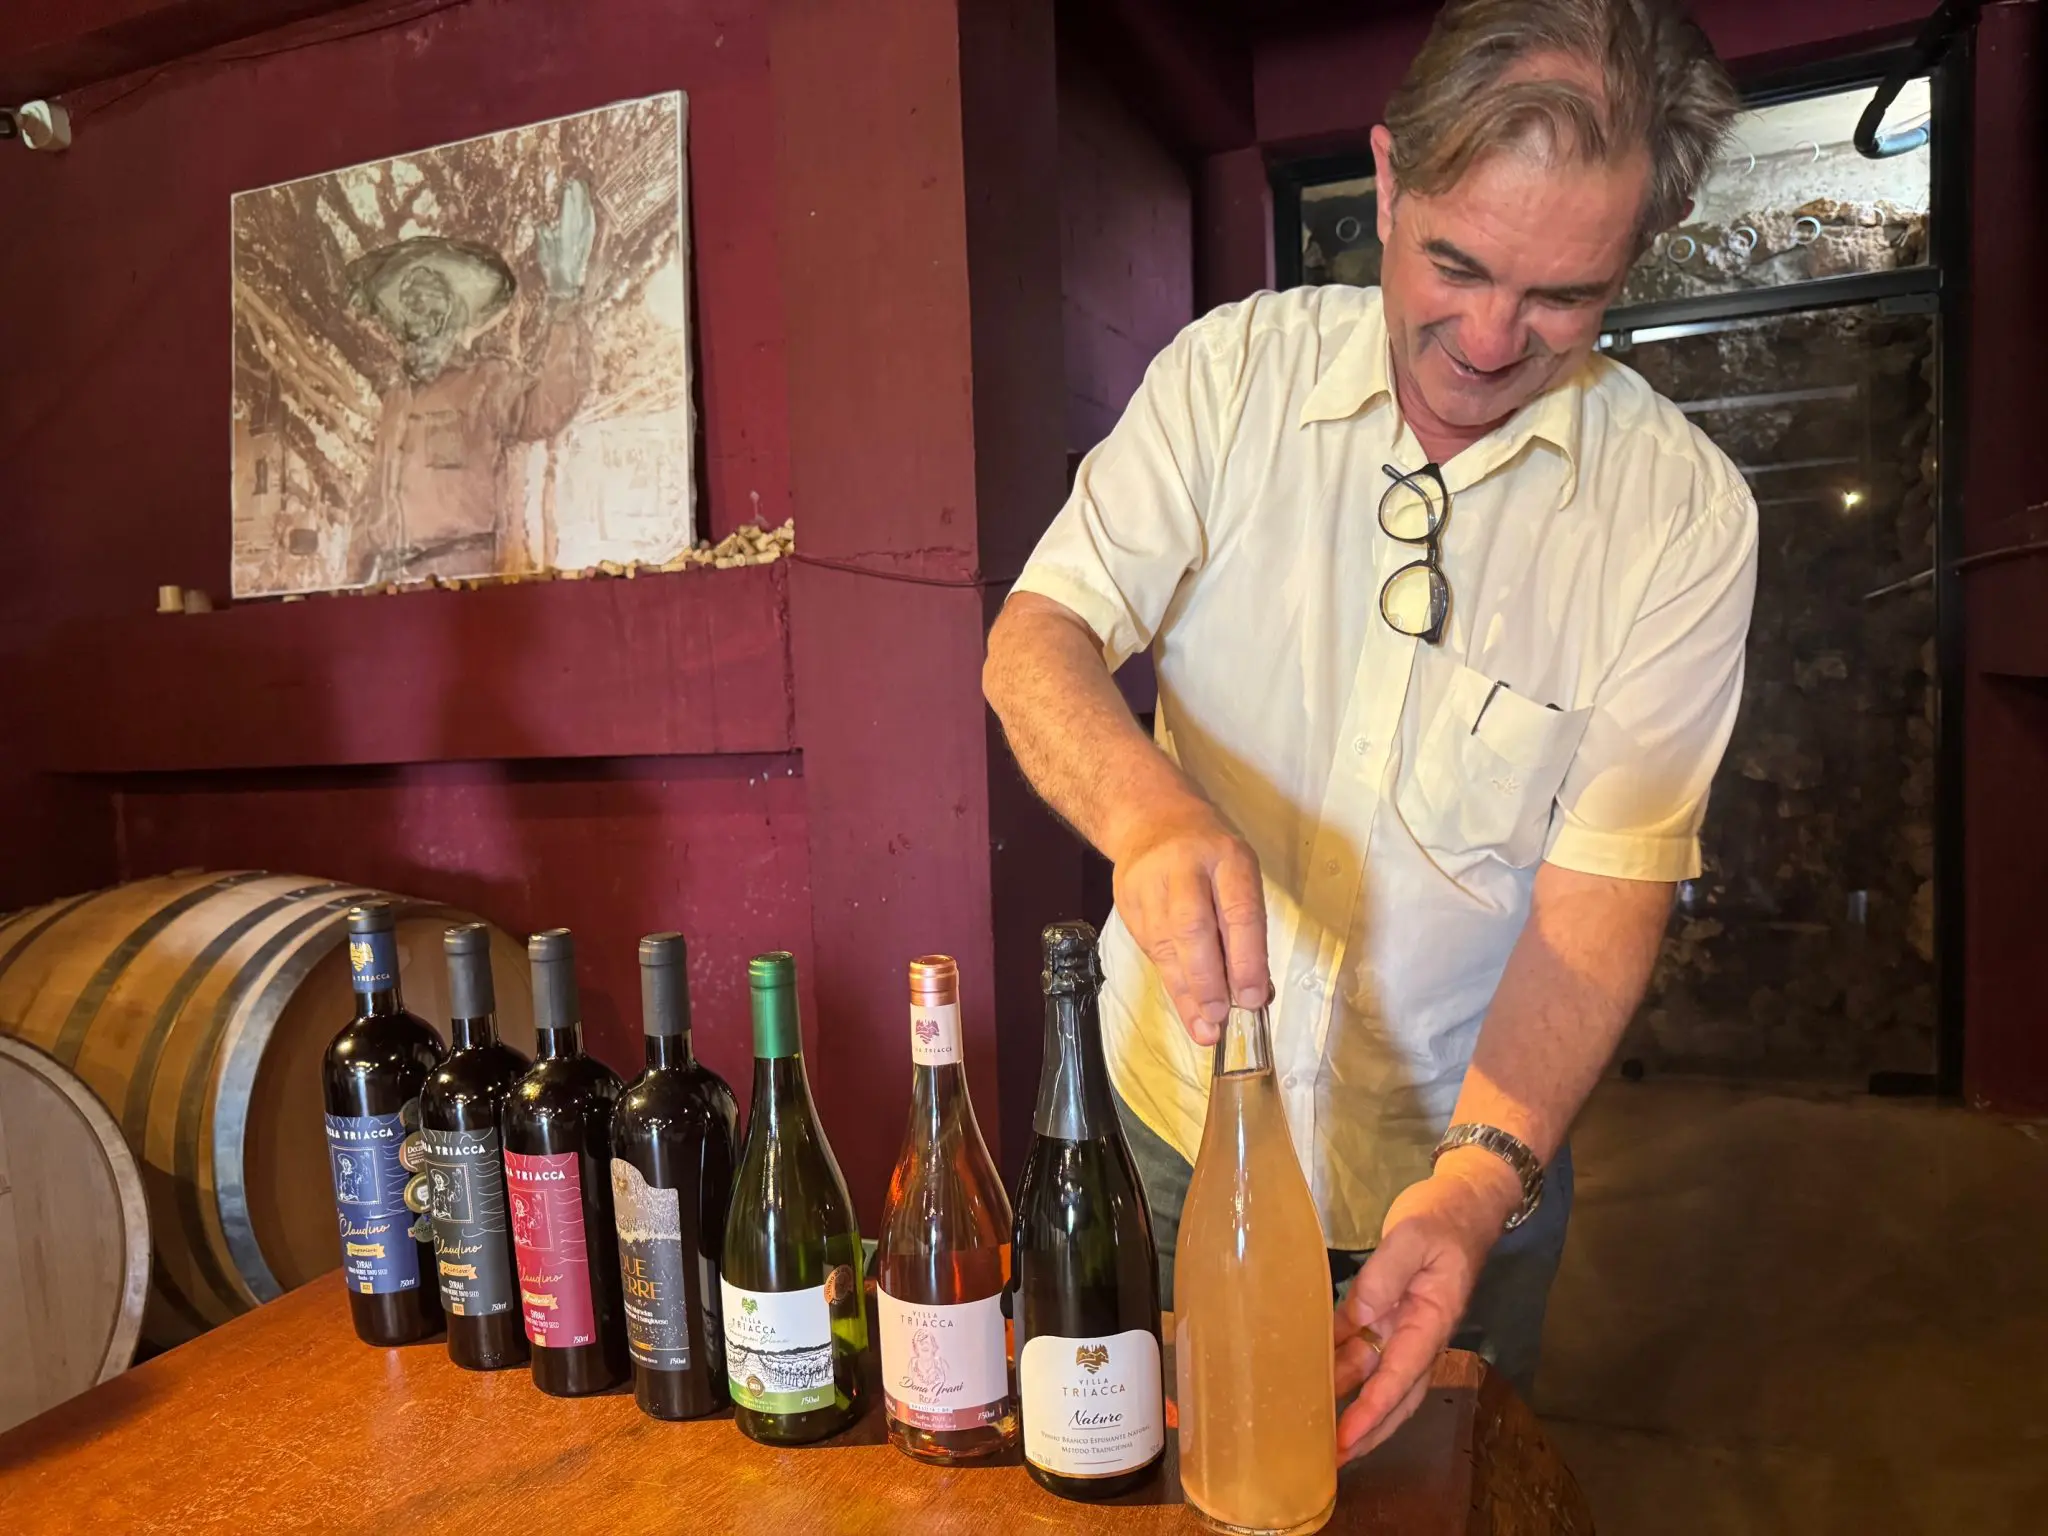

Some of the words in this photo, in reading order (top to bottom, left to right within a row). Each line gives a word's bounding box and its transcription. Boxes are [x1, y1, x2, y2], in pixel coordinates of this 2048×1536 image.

[343, 1127, 394, 1140] TRIACCA
[435, 1144, 486, 1156] TRIACCA
[516, 1170, 566, 1181] TRIACCA
[340, 1218, 390, 1239] Claudino
[434, 1235, 482, 1259] Claudino
[400, 1277, 415, 1288] 750ml
[491, 1302, 507, 1312] 750ml
[912, 1310, 938, 1319] VILLA
[732, 1317, 776, 1334] TRIACCA
[901, 1314, 954, 1328] TRIACCA
[573, 1334, 589, 1344] 750ml
[899, 1375, 928, 1393] Dona
[931, 1381, 964, 1397] Irani
[1079, 1378, 1109, 1386] VILLA
[1062, 1385, 1126, 1398] TRIACCA
[977, 1410, 995, 1421] 750ml
[1068, 1410, 1123, 1427] Nature
